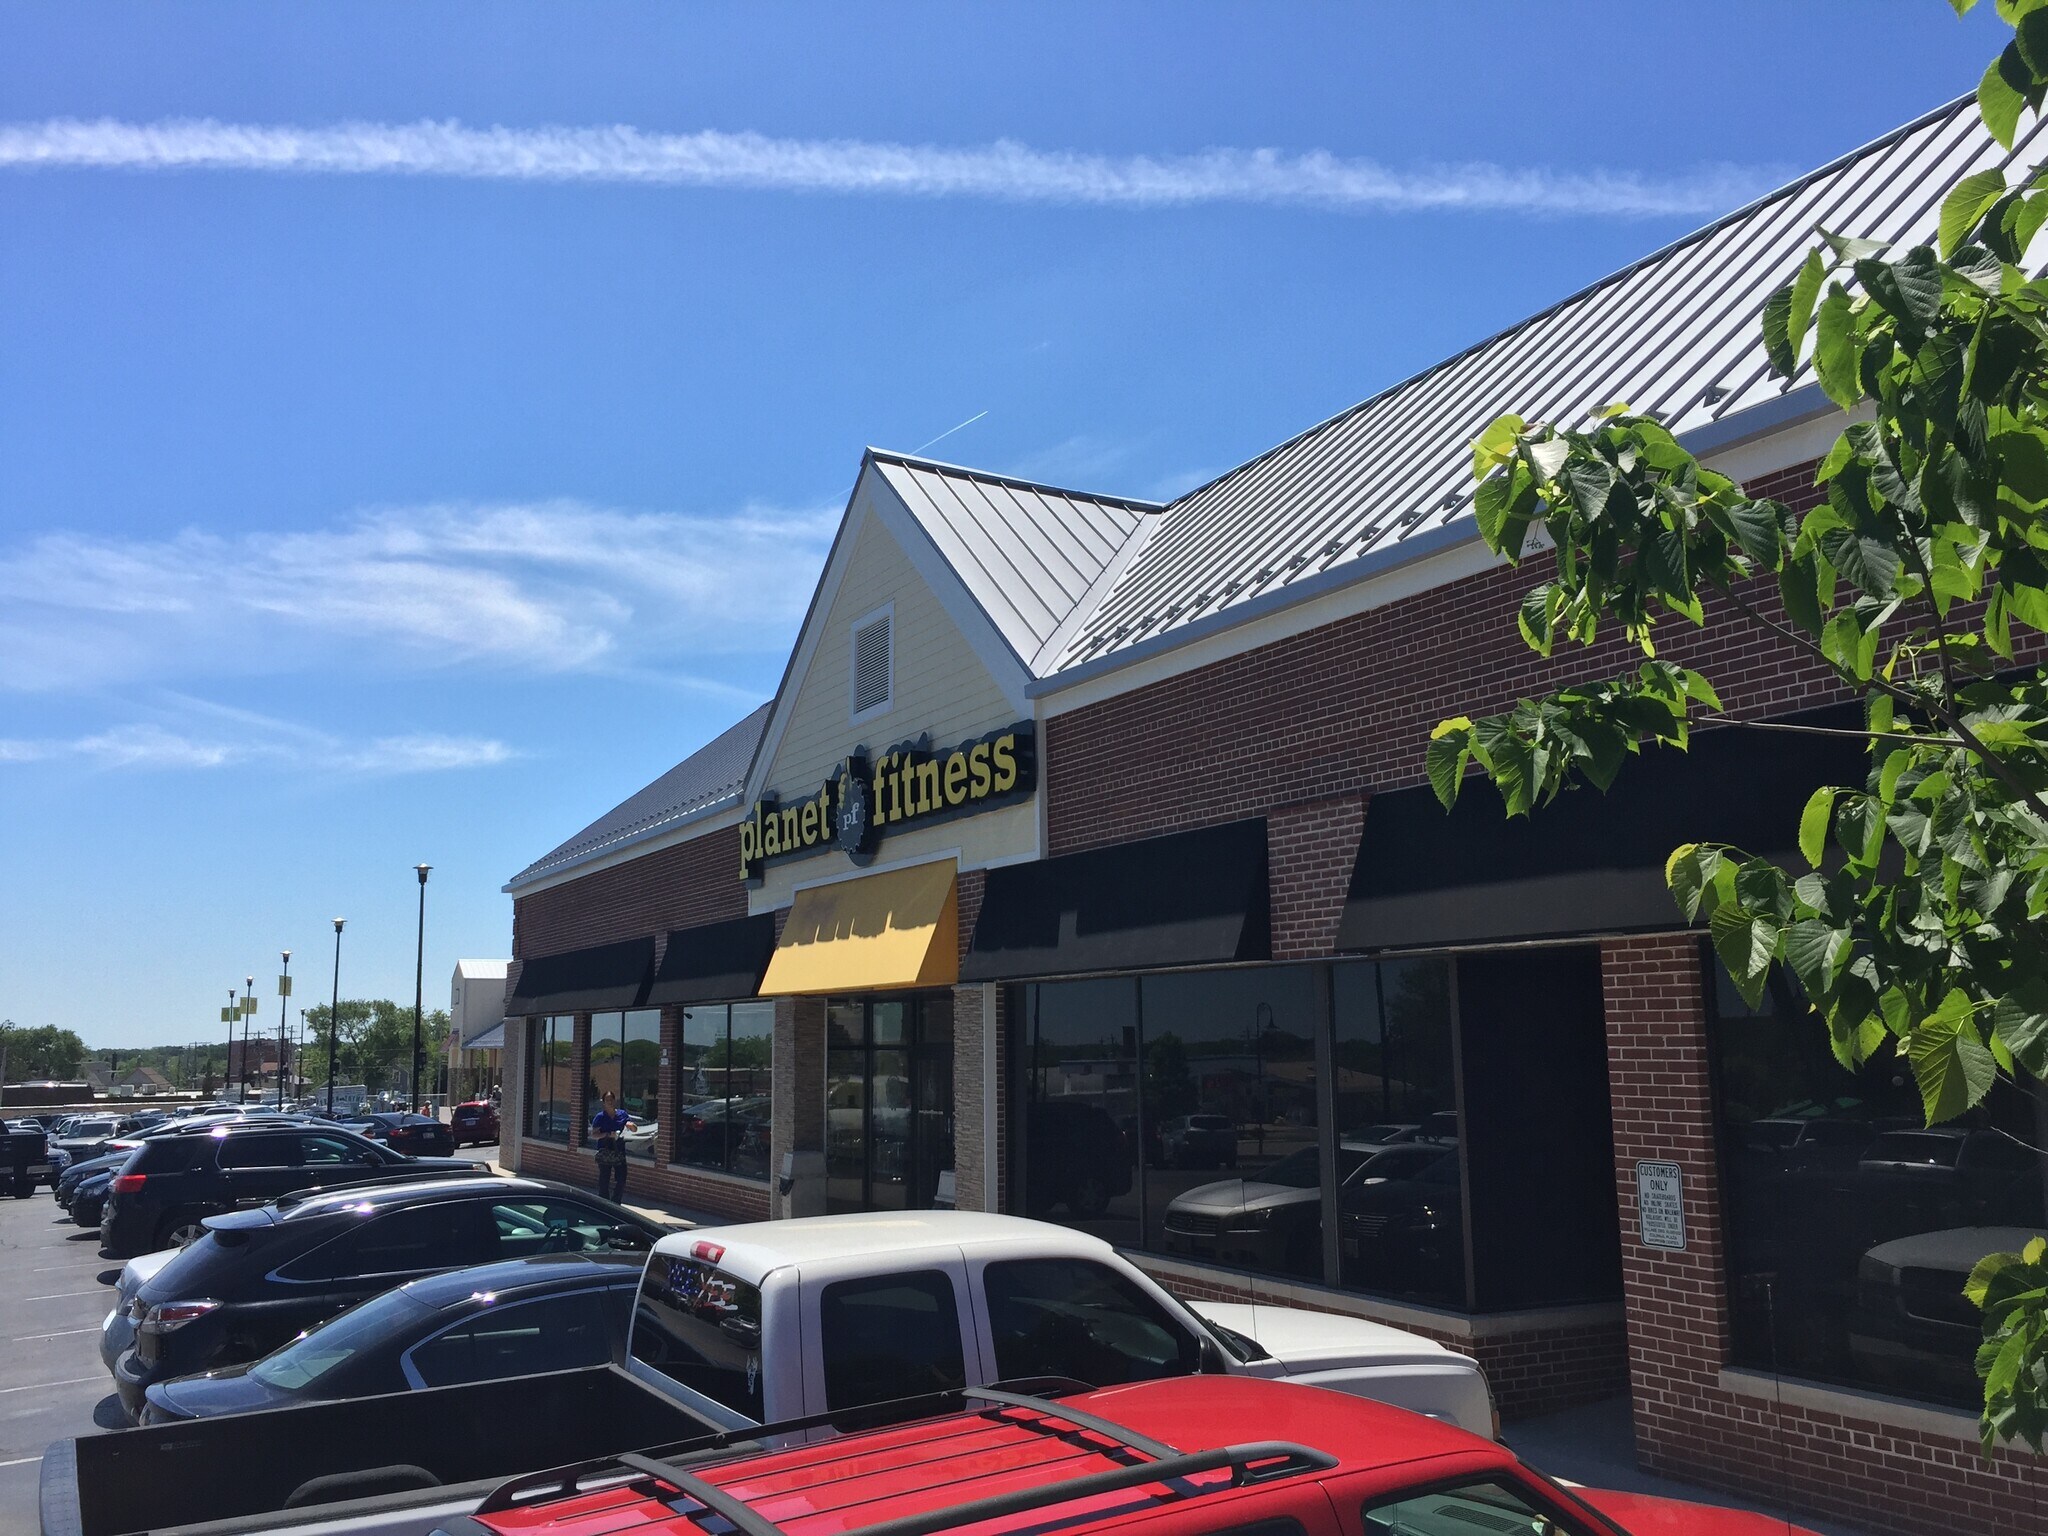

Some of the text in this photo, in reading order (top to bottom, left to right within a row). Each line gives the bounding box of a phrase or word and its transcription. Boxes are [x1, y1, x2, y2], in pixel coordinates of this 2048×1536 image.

[739, 734, 1016, 879] planet fitness
[843, 802, 859, 830] pf
[1640, 1165, 1677, 1179] CUSTOMERS
[1650, 1180, 1668, 1191] ONLY
